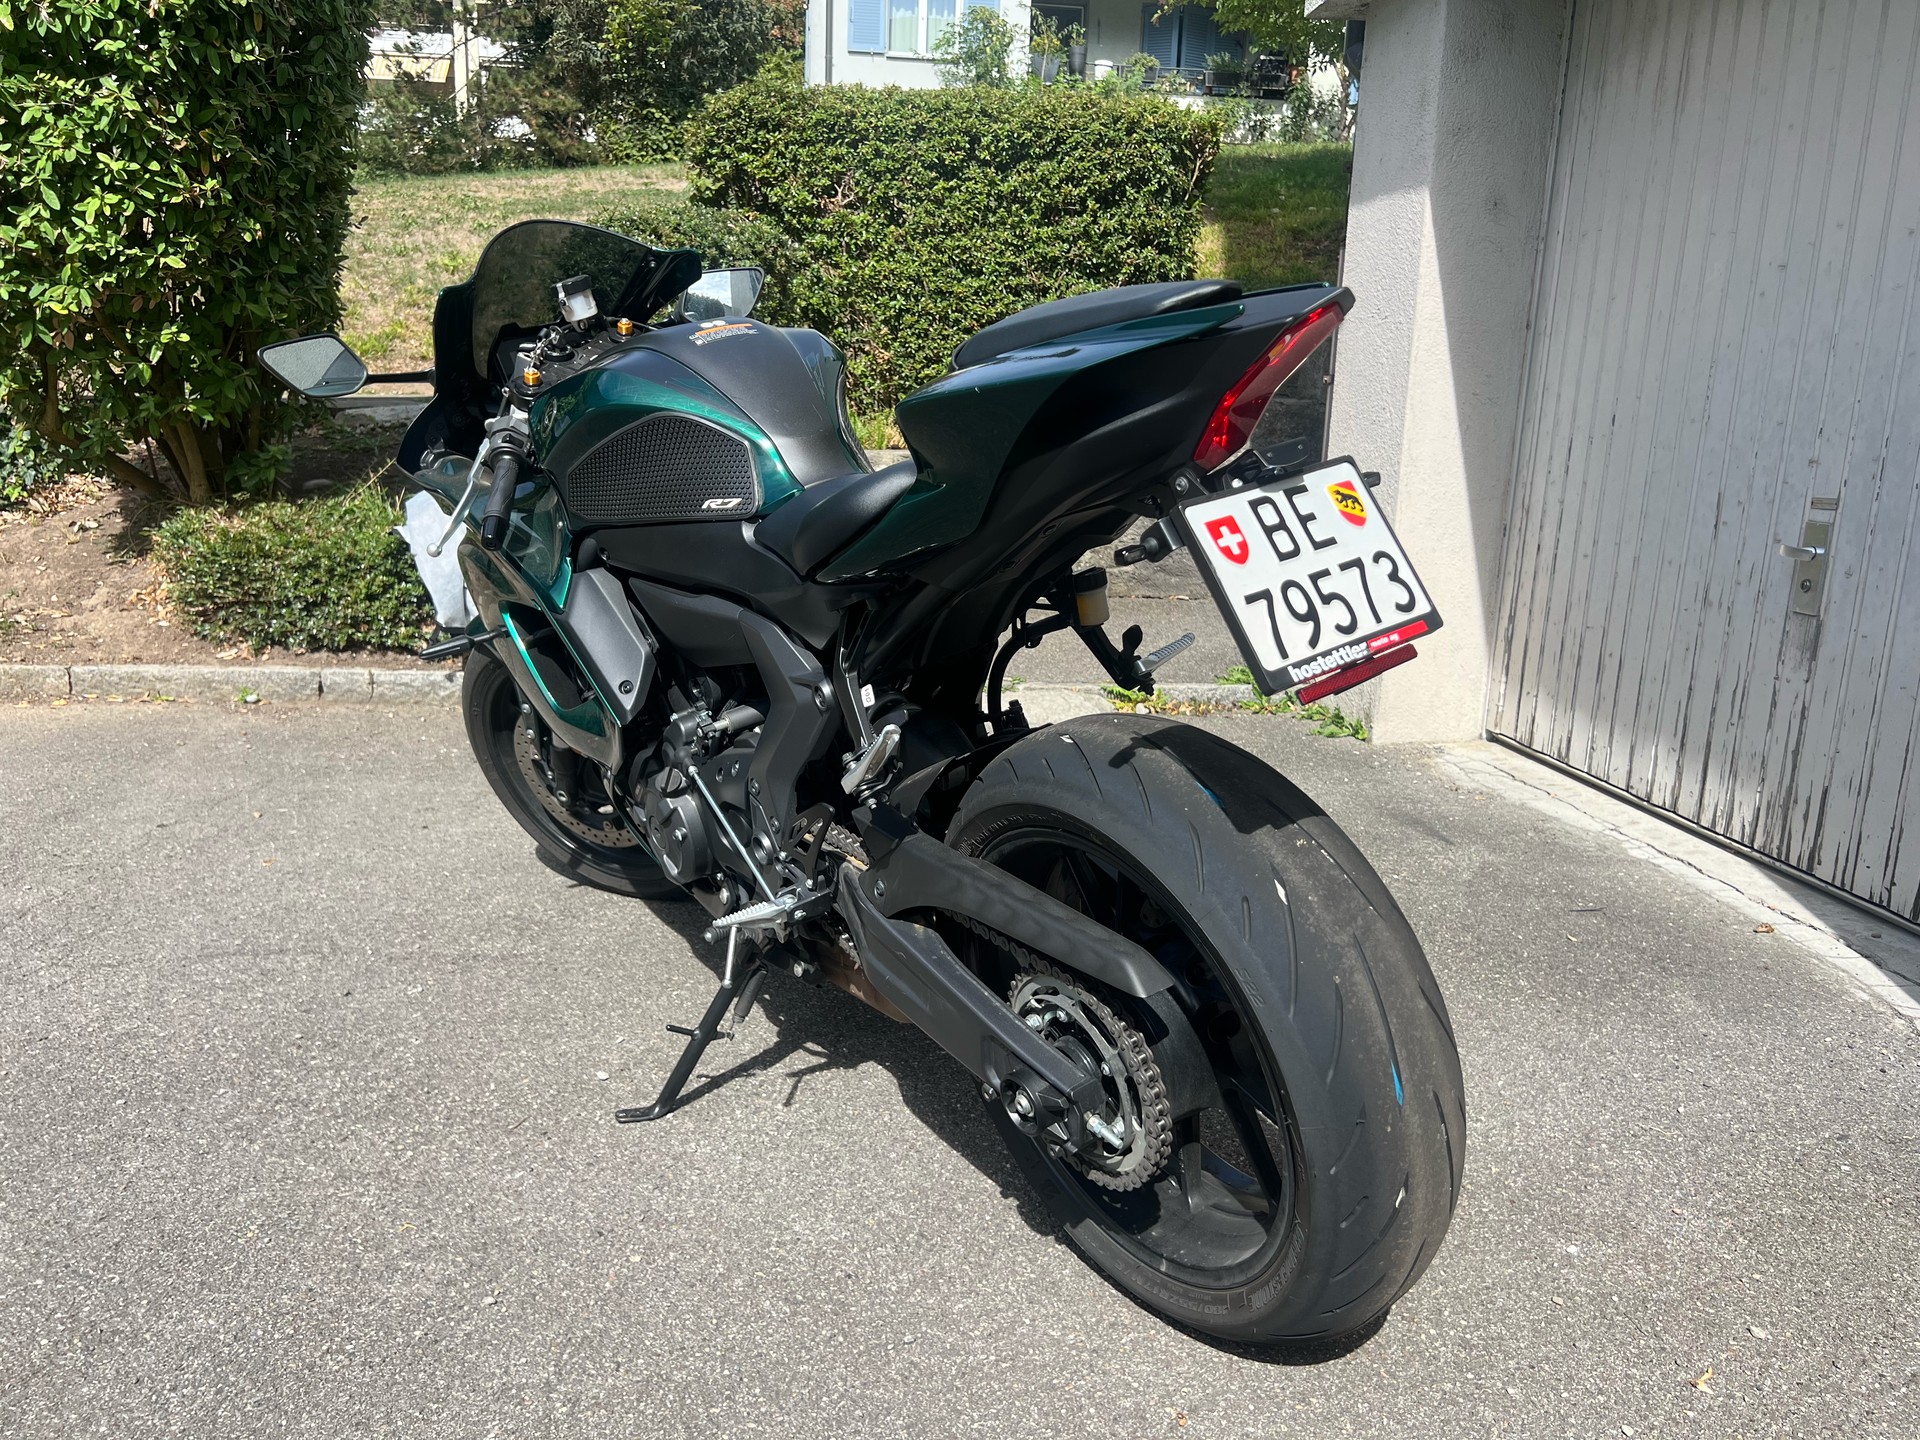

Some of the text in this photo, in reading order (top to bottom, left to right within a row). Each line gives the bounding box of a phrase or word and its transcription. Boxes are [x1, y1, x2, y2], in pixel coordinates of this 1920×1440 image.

[701, 497, 743, 509] R7
[1247, 484, 1338, 562] BE
[1244, 550, 1416, 660] 79573
[1287, 641, 1369, 683] hostettler
